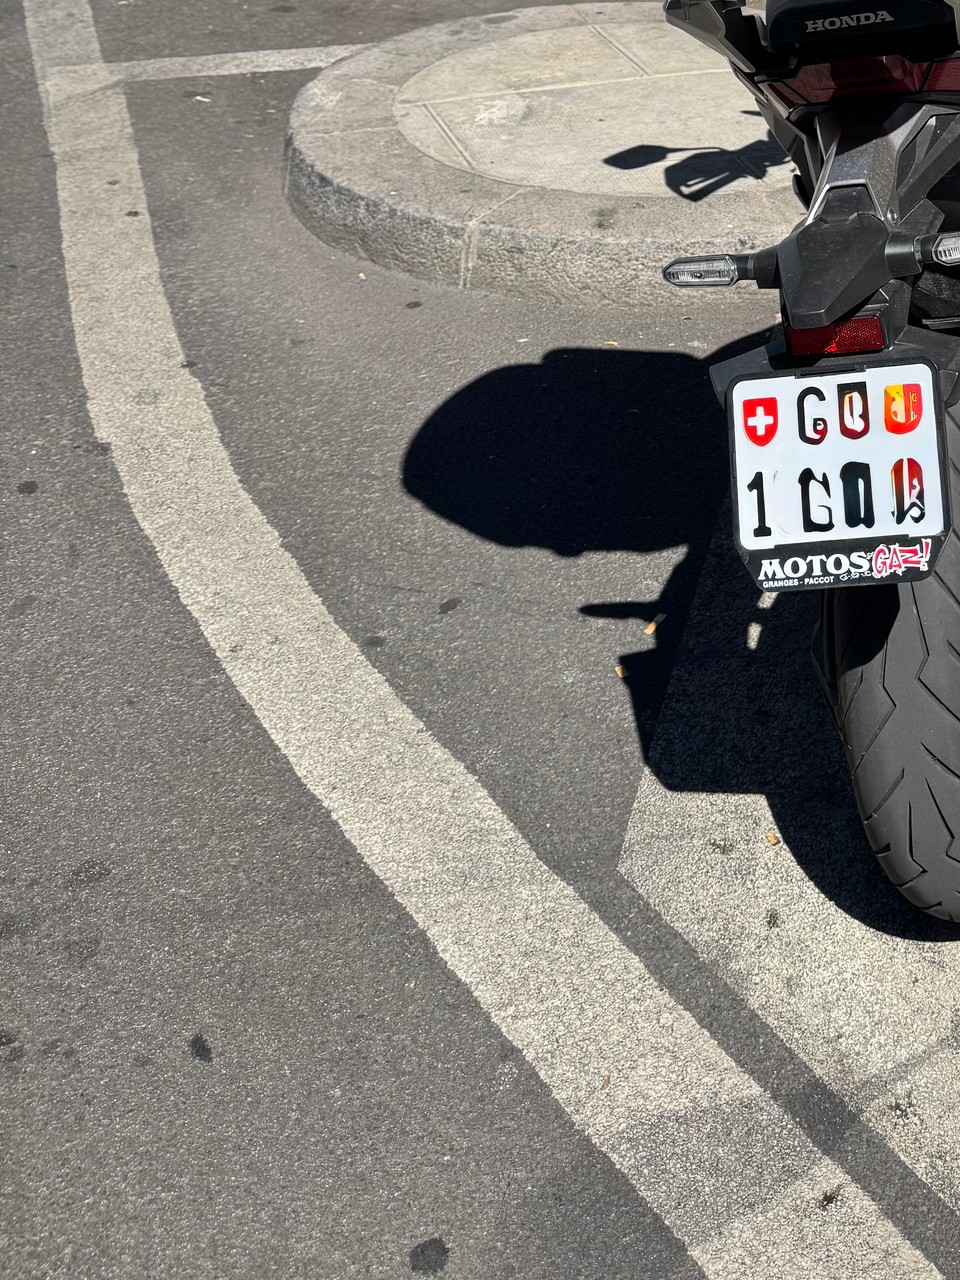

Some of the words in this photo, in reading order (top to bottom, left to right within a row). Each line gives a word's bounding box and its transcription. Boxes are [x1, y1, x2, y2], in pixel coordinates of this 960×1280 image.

[805, 10, 895, 32] HONDA
[757, 551, 870, 581] MOTOS
[762, 579, 799, 588] GRANGES
[804, 576, 835, 585] PACCOT
